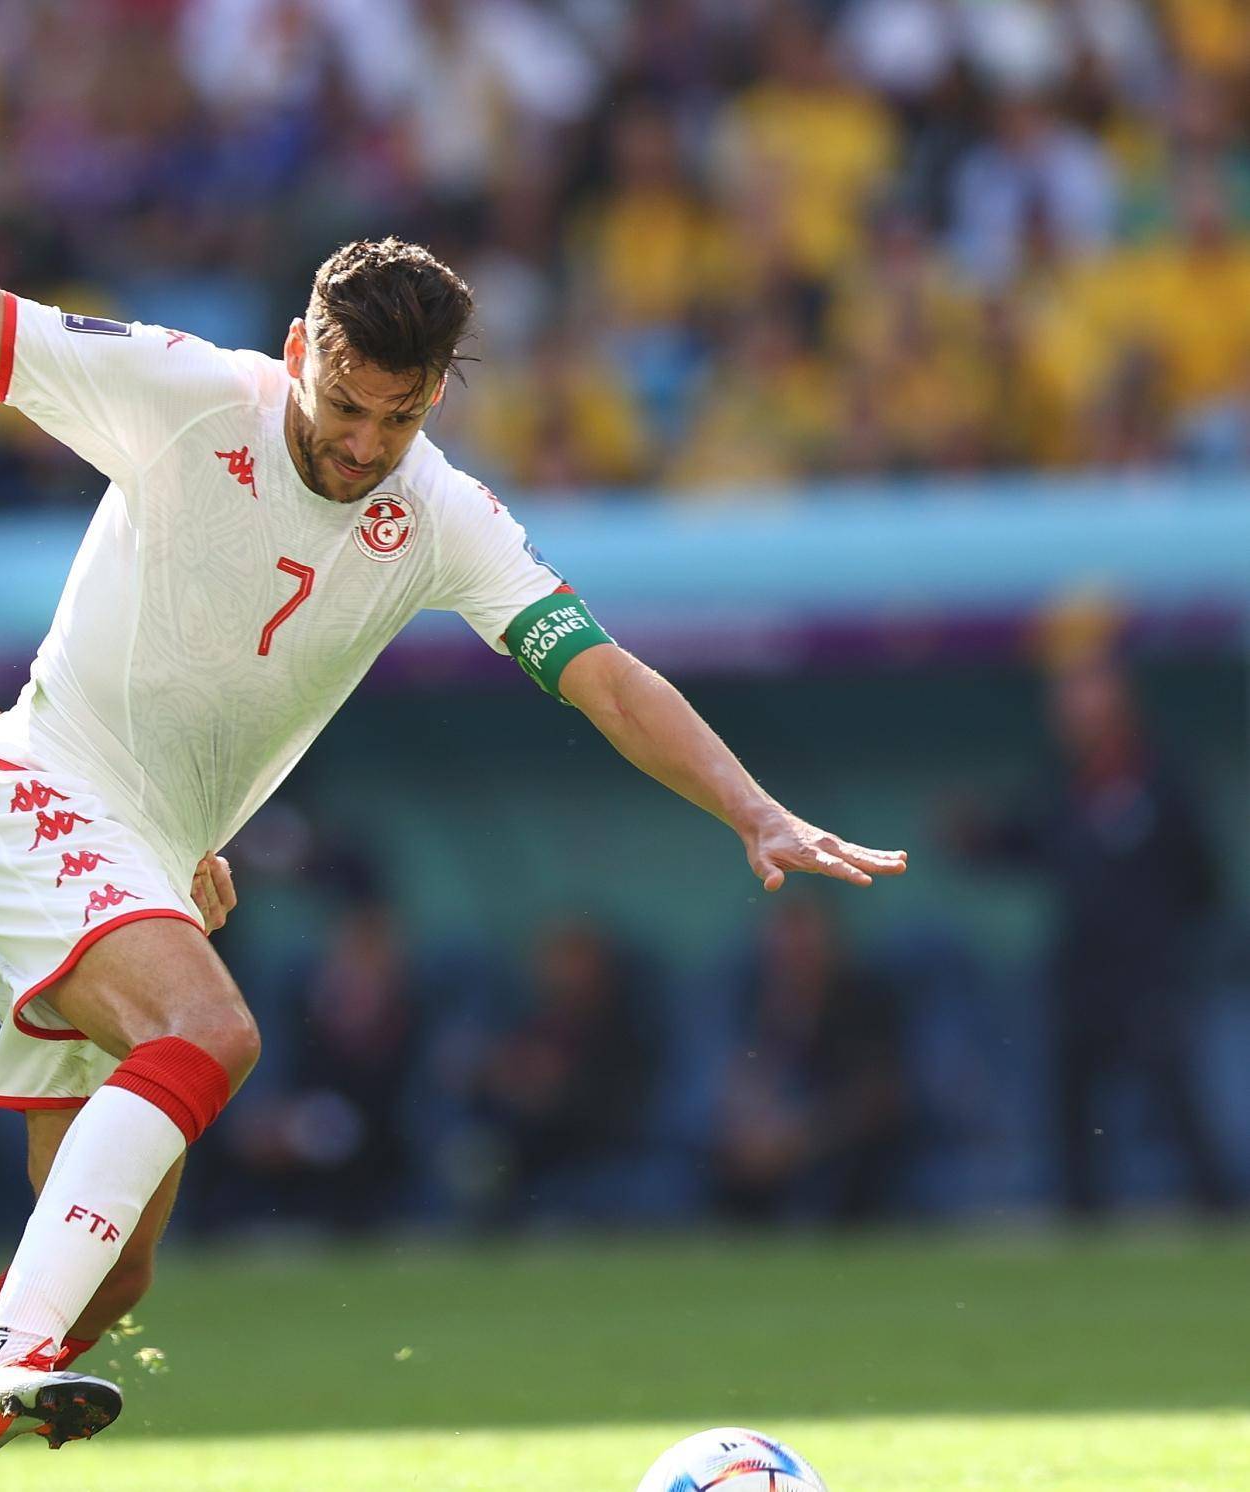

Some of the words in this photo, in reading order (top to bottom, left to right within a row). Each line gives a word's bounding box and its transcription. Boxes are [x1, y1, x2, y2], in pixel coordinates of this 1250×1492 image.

[257, 556, 315, 656] 7
[520, 617, 552, 659] SAVE
[547, 606, 582, 623] THE
[64, 1204, 120, 1243] FTF
